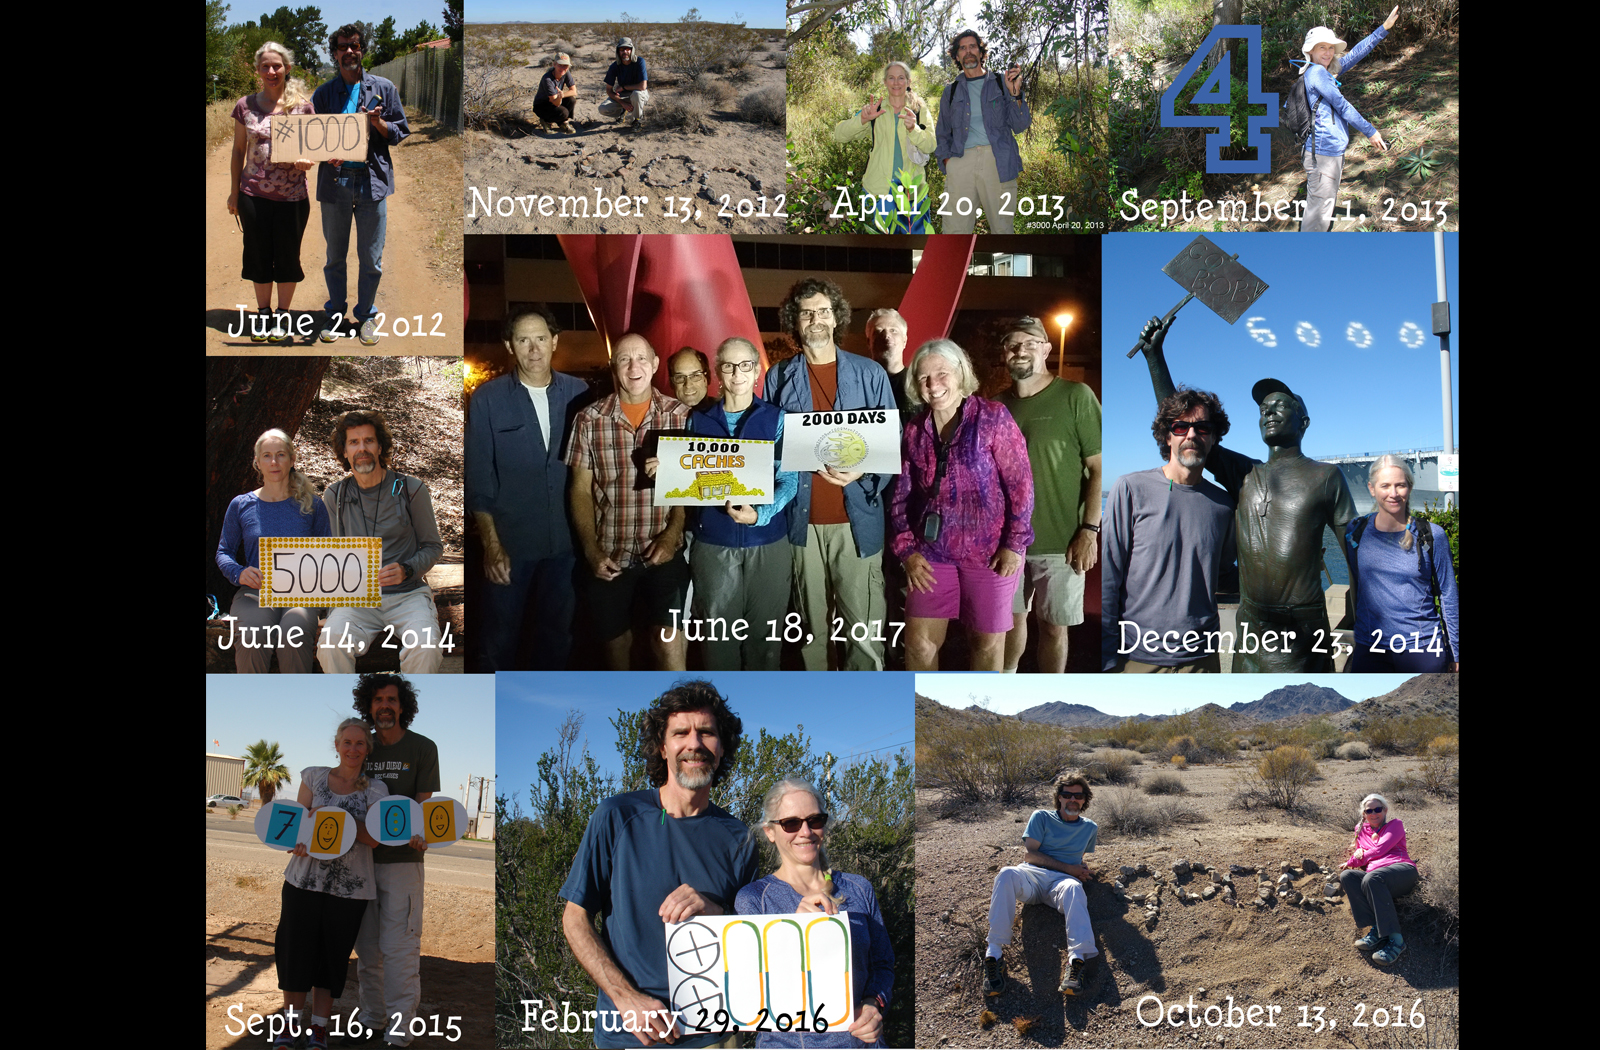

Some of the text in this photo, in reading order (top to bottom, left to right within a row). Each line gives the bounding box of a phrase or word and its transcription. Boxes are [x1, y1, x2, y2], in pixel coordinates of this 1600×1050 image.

[274, 115, 361, 155] #1000
[802, 411, 887, 426] 2000 DAYS
[688, 441, 740, 453] 10,000
[679, 454, 746, 469] CACHES
[271, 552, 362, 593] 5000
[374, 761, 386, 770] SAN
[386, 761, 402, 770] DIEGO
